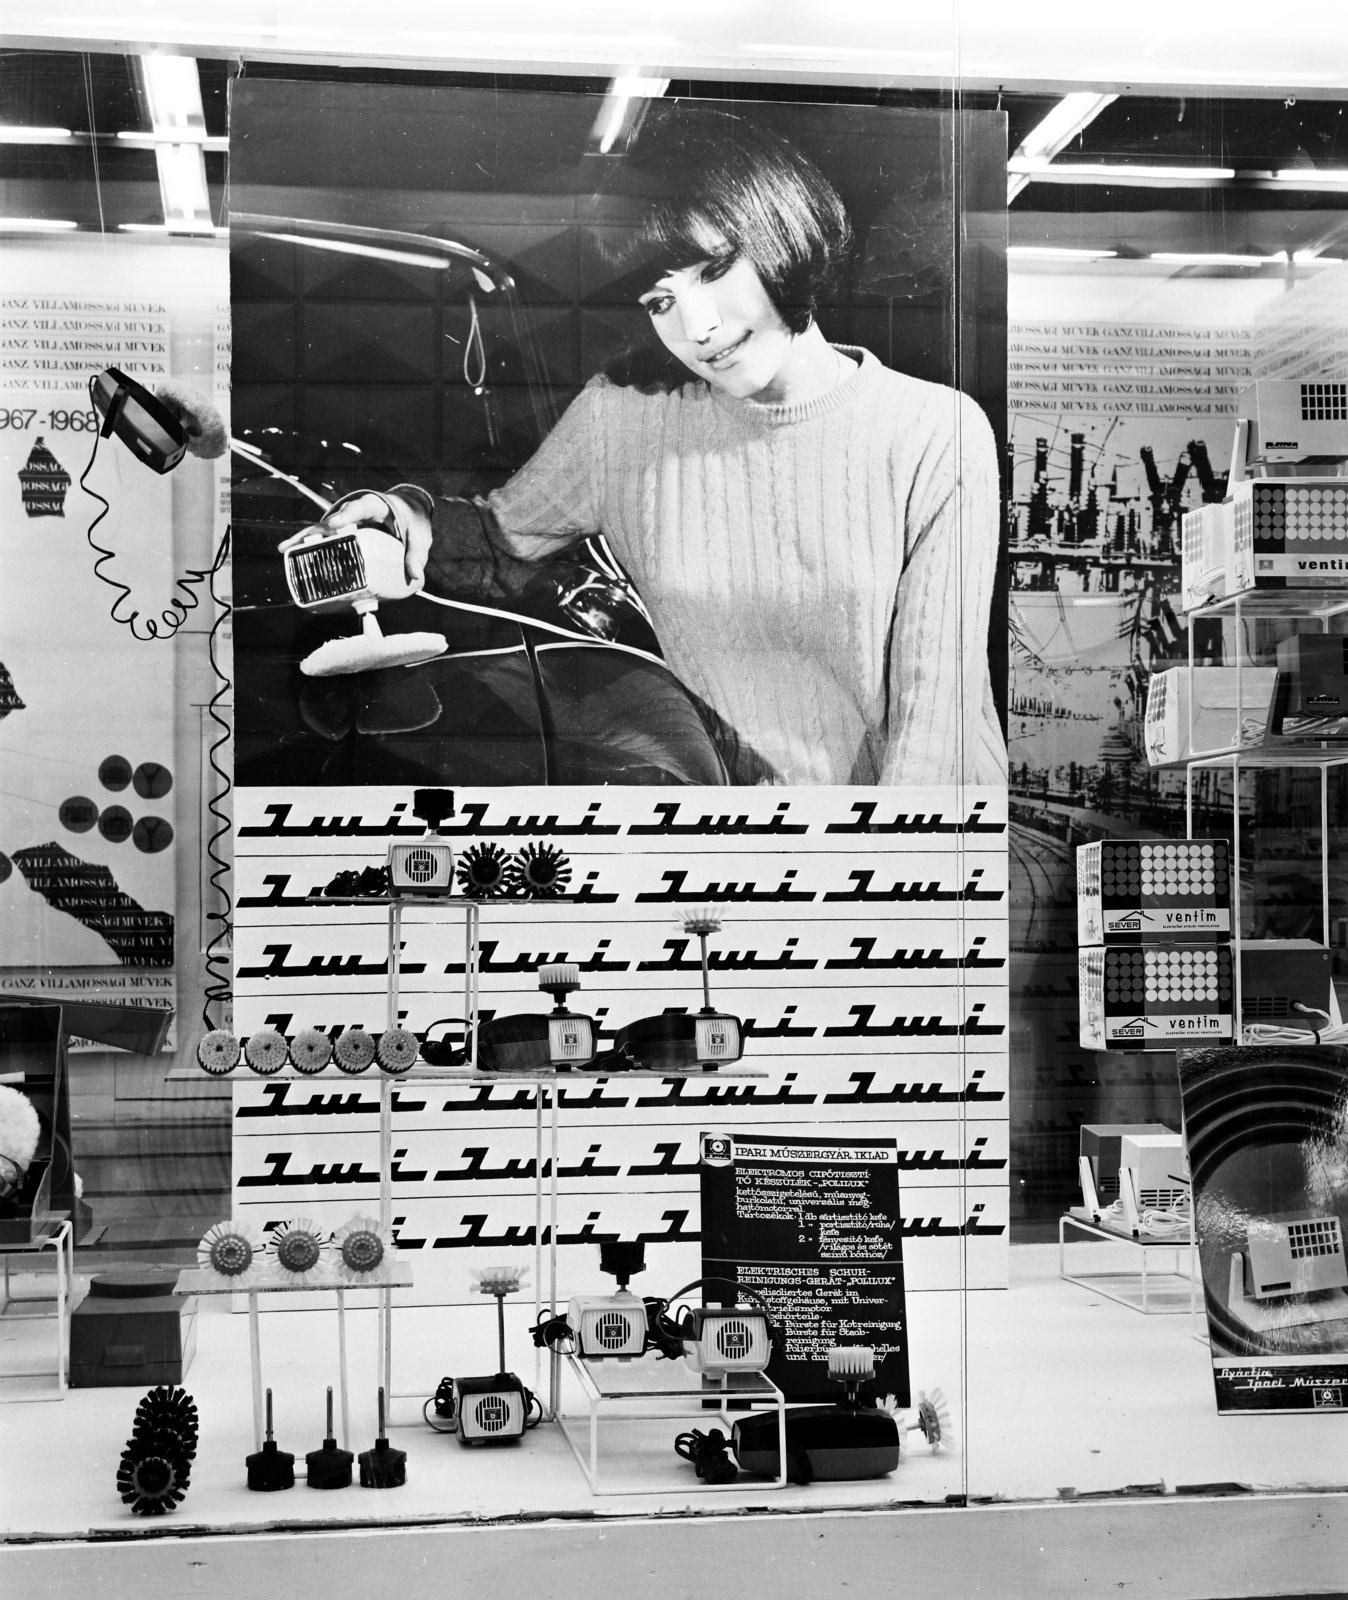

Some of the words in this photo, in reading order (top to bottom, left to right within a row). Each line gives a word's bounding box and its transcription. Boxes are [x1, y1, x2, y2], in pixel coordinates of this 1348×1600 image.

[1103, 328, 1132, 337] GANZ
[1103, 346, 1132, 356] GANZ
[1103, 365, 1132, 374] GANZ
[1103, 384, 1132, 393] GANZ
[1103, 402, 1132, 412] GANZ
[1298, 559, 1348, 570] venti
[1109, 921, 1139, 929] SEVER
[1166, 909, 1216, 922] ventim
[2, 978, 35, 989] GANZ
[1169, 1015, 1219, 1028] ventim
[735, 1148, 767, 1157] IPARI
[854, 1151, 889, 1160] IKLAD
[735, 1168, 805, 1177] ELEKTROMOS
[736, 1176, 751, 1185] TÓ
[798, 1212, 804, 1220] 1
[805, 1212, 817, 1220] db
[869, 1212, 887, 1220] kefe
[798, 1220, 805, 1228] 1
[820, 1228, 839, 1236] kefe
[864, 1235, 884, 1243] kefe
[736, 1267, 819, 1276] ELEKTRISCHES
[829, 1268, 871, 1276] SCHUH-
[815, 1288, 843, 1297] Gerät
[845, 1289, 859, 1297] im
[831, 1296, 850, 1304] mit
[852, 1296, 888, 1304] Univer-
[785, 1320, 819, 1328] Bürste
[820, 1320, 837, 1328] für
[839, 1320, 902, 1331] Kotreinigung
[785, 1328, 818, 1336] Bürste
[820, 1328, 837, 1336] für
[839, 1328, 870, 1336] Staub-
[786, 1337, 836, 1347] reinigung
